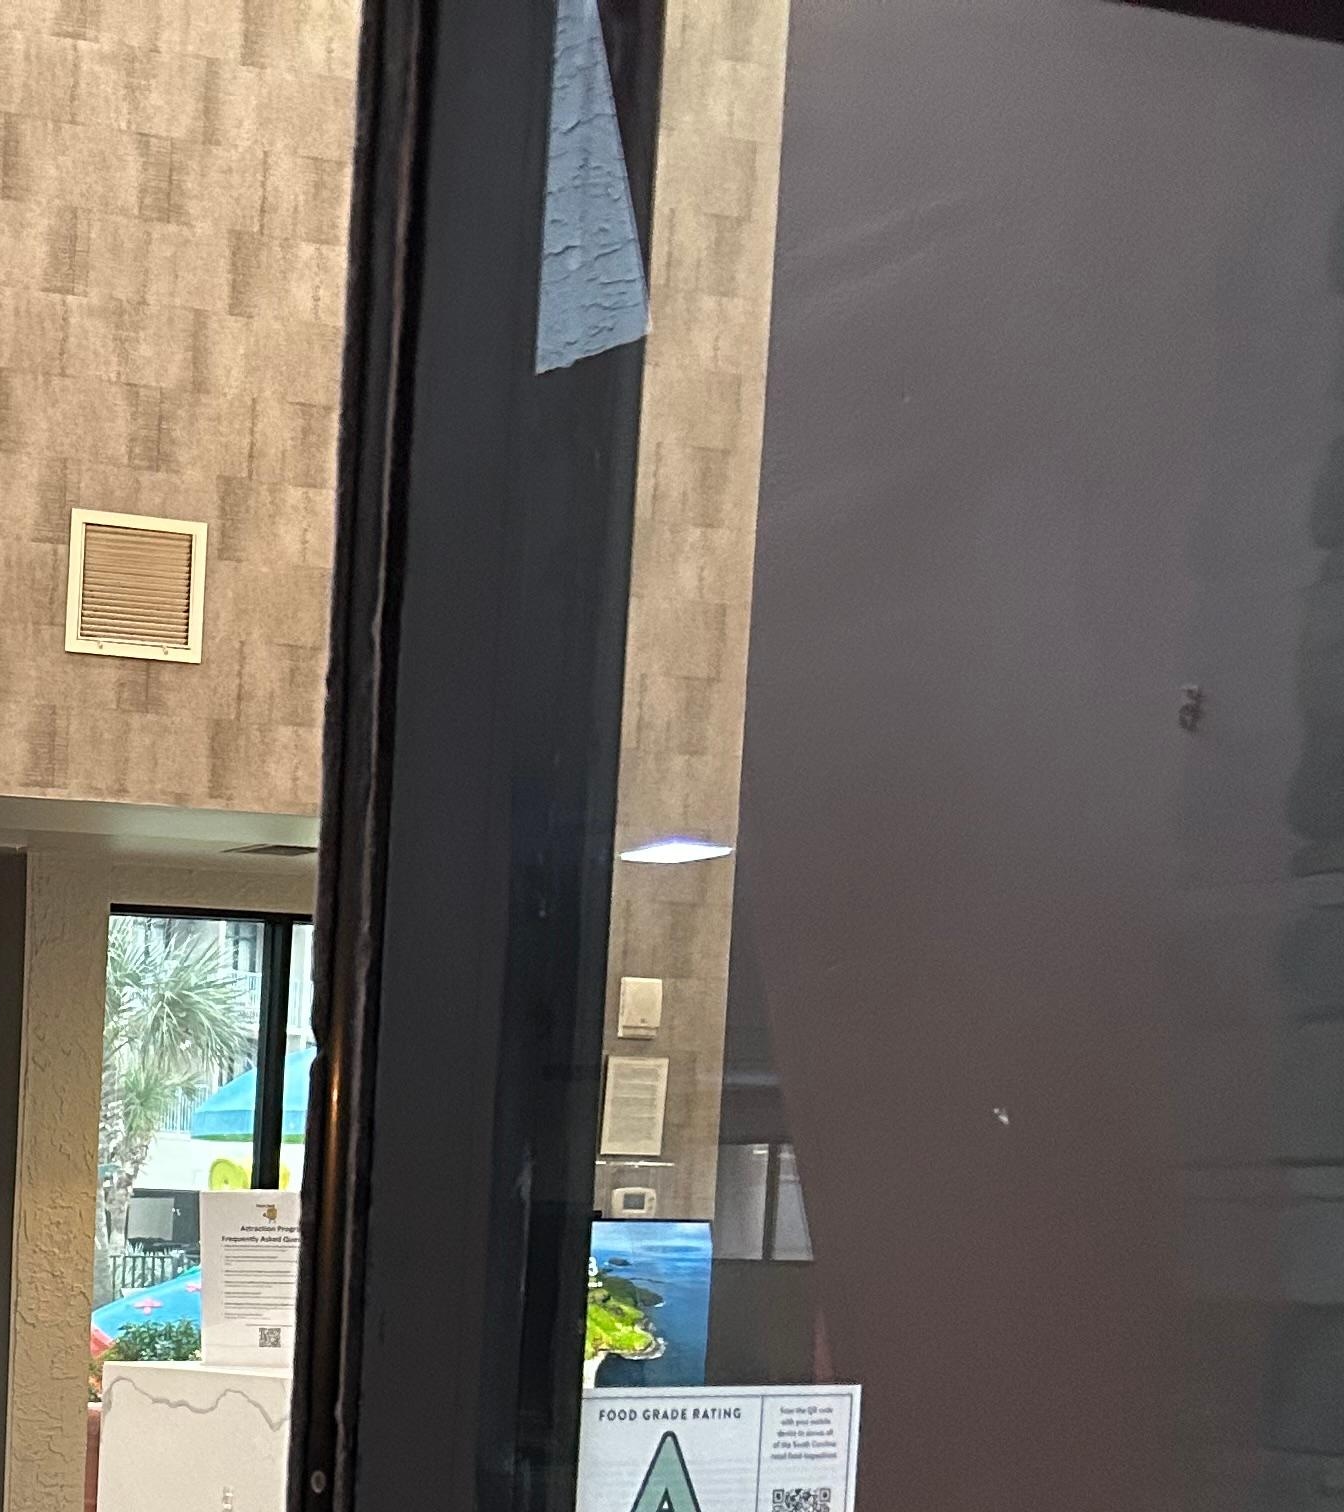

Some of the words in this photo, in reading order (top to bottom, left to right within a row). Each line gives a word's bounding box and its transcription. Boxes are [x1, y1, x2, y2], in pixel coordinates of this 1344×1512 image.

[599, 1408, 638, 1421] FOOD
[642, 1407, 688, 1421] GRADE
[692, 1407, 742, 1419] RATING
